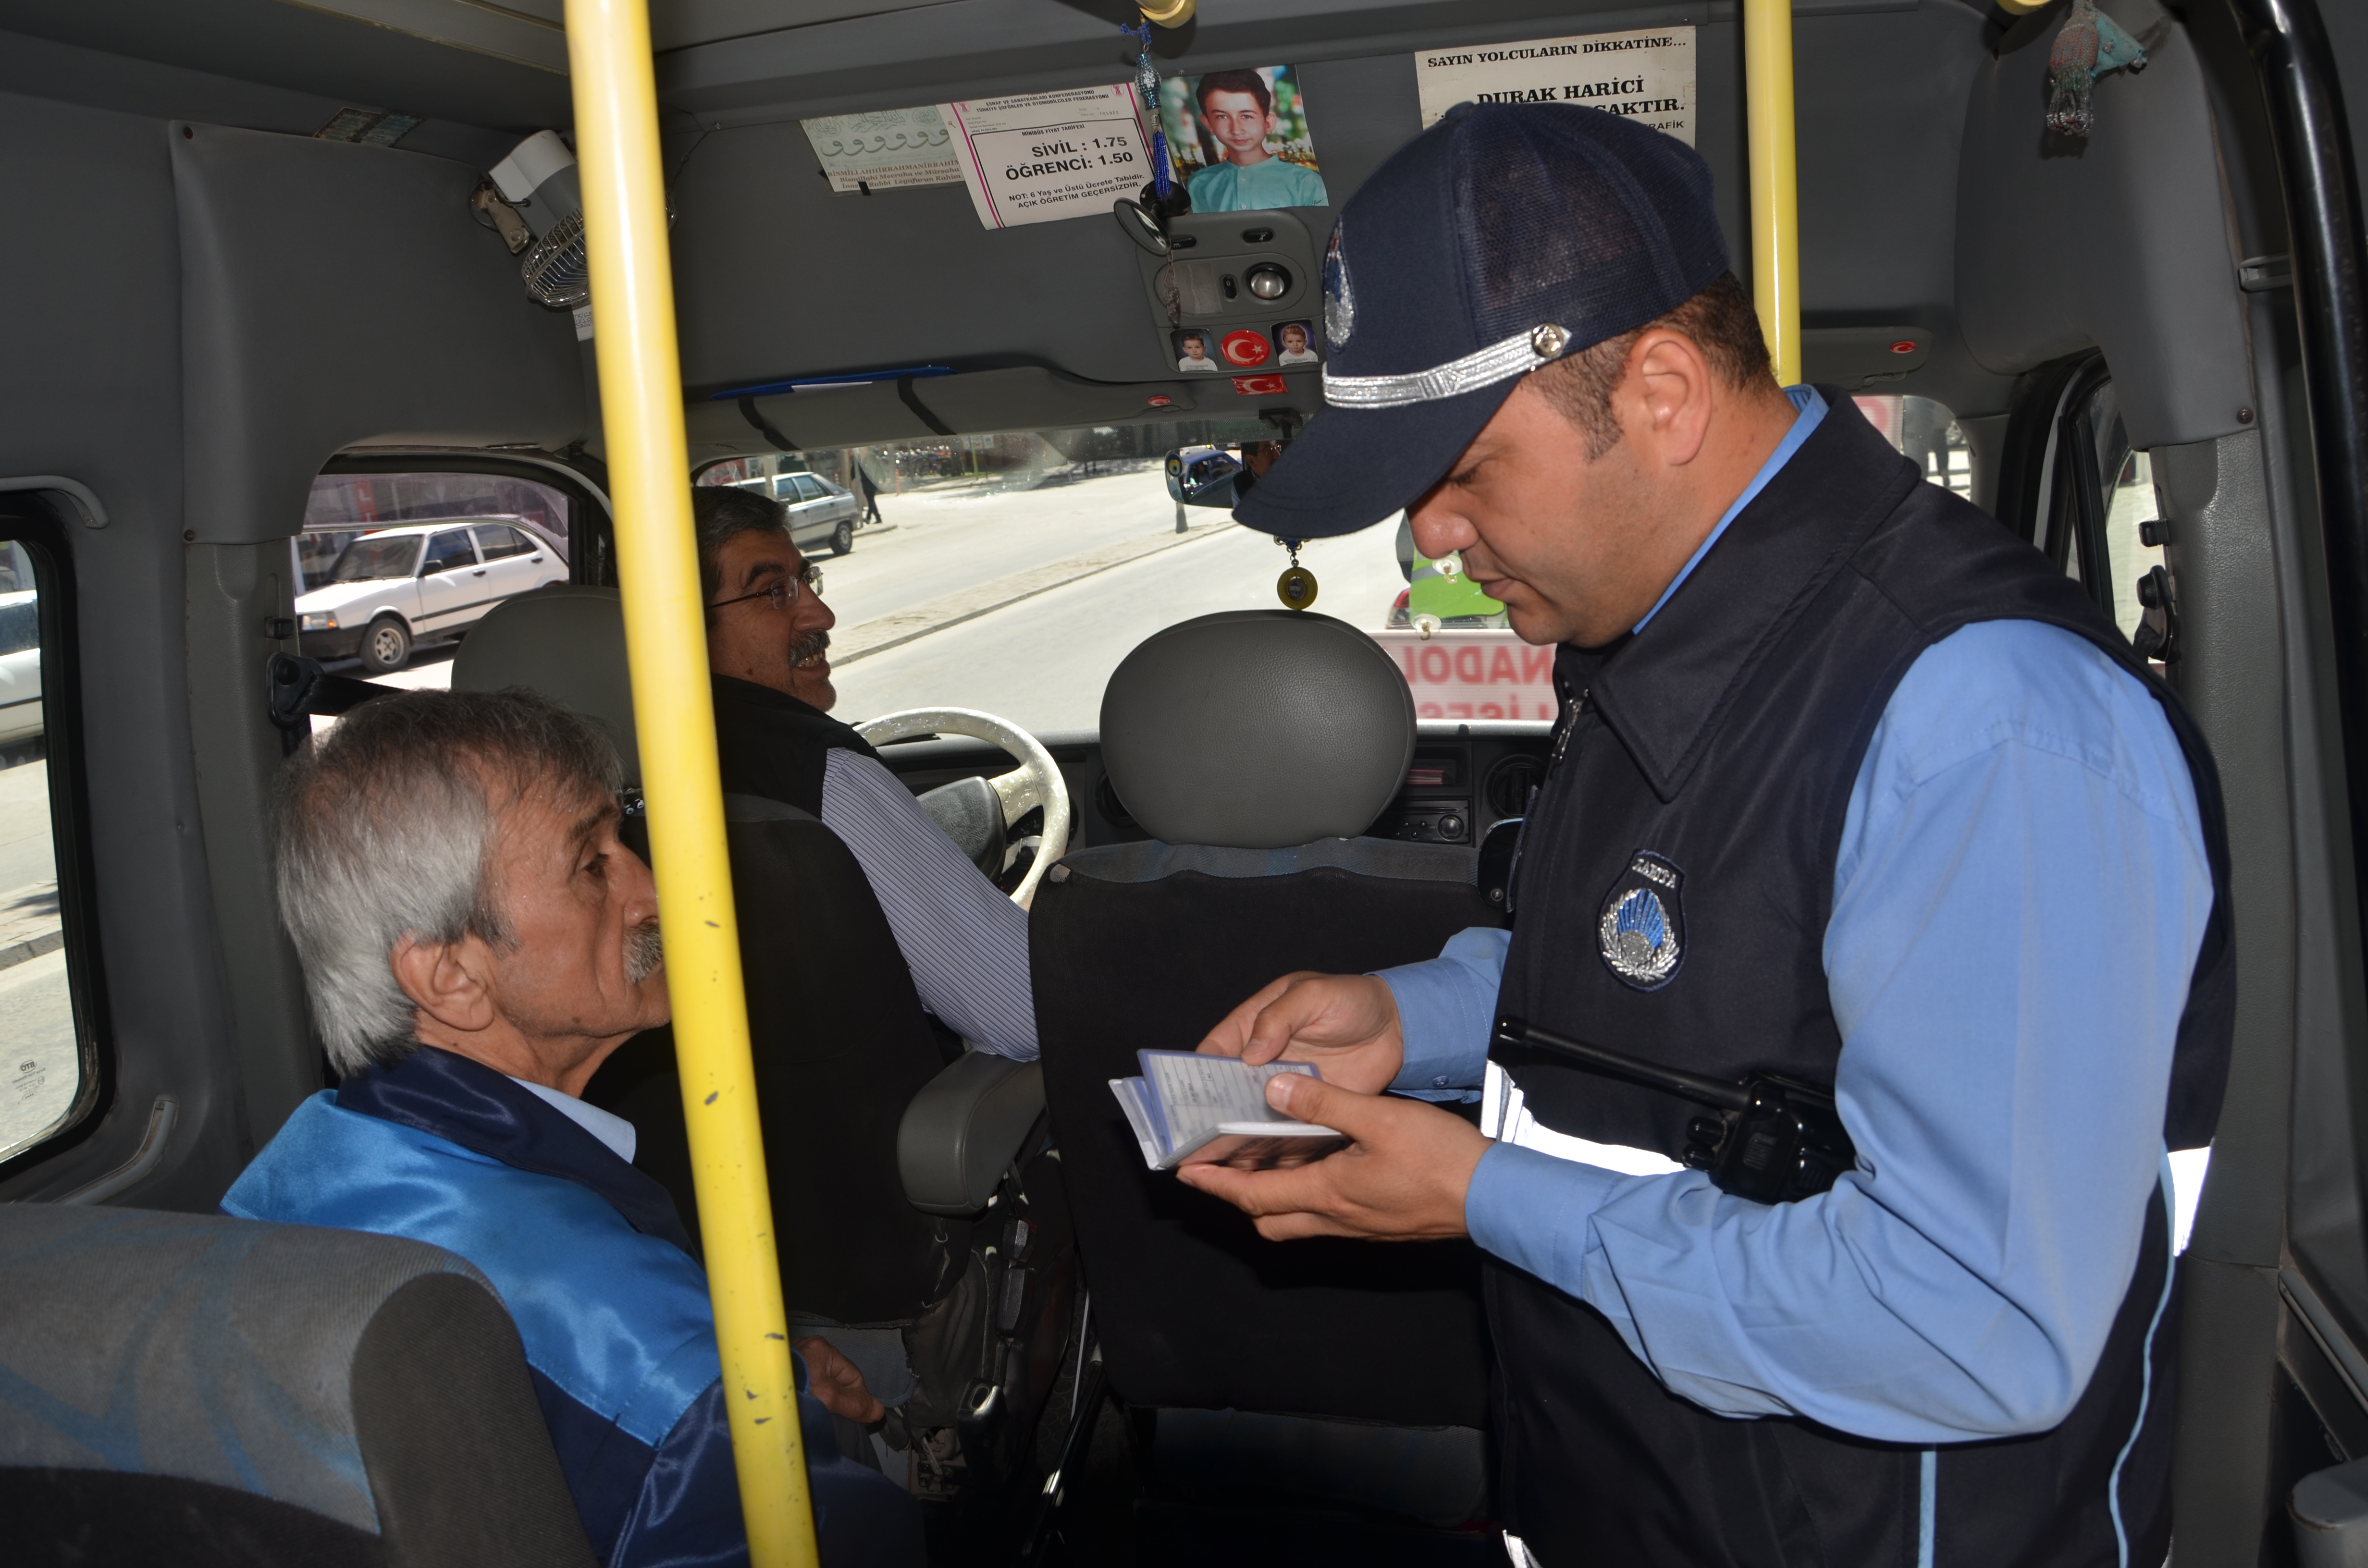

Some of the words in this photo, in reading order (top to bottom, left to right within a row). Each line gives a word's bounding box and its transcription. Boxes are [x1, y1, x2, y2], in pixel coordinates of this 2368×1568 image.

[1428, 54, 1472, 67] SAYIN
[1477, 45, 1579, 62] YOLCULARIN
[1011, 95, 1048, 103] SANATKARLARI
[1048, 89, 1095, 99] KONFEDERASYONU
[1477, 87, 1557, 104] DURAK
[1564, 75, 1644, 99] HARİCİ
[1033, 98, 1072, 106] OTOMOBİLCİLER
[1022, 128, 1044, 136] MİNİBÜS
[1645, 120, 1684, 130] RAFİK
[1032, 140, 1078, 158] SİVİL
[1092, 136, 1127, 149] 1.75
[1006, 155, 1093, 180] ÖĞRENCİ:
[1098, 152, 1133, 166] 1.50
[1009, 193, 1029, 201] NOT:
[1036, 189, 1052, 197] Yaş
[1065, 184, 1084, 192] Üstü
[1085, 180, 1113, 189] Ücrete
[1018, 200, 1038, 208] AÇIK
[1040, 193, 1079, 204] ÖĞRETİM
[1081, 182, 1141, 197] GEÇERSİZDİR.
